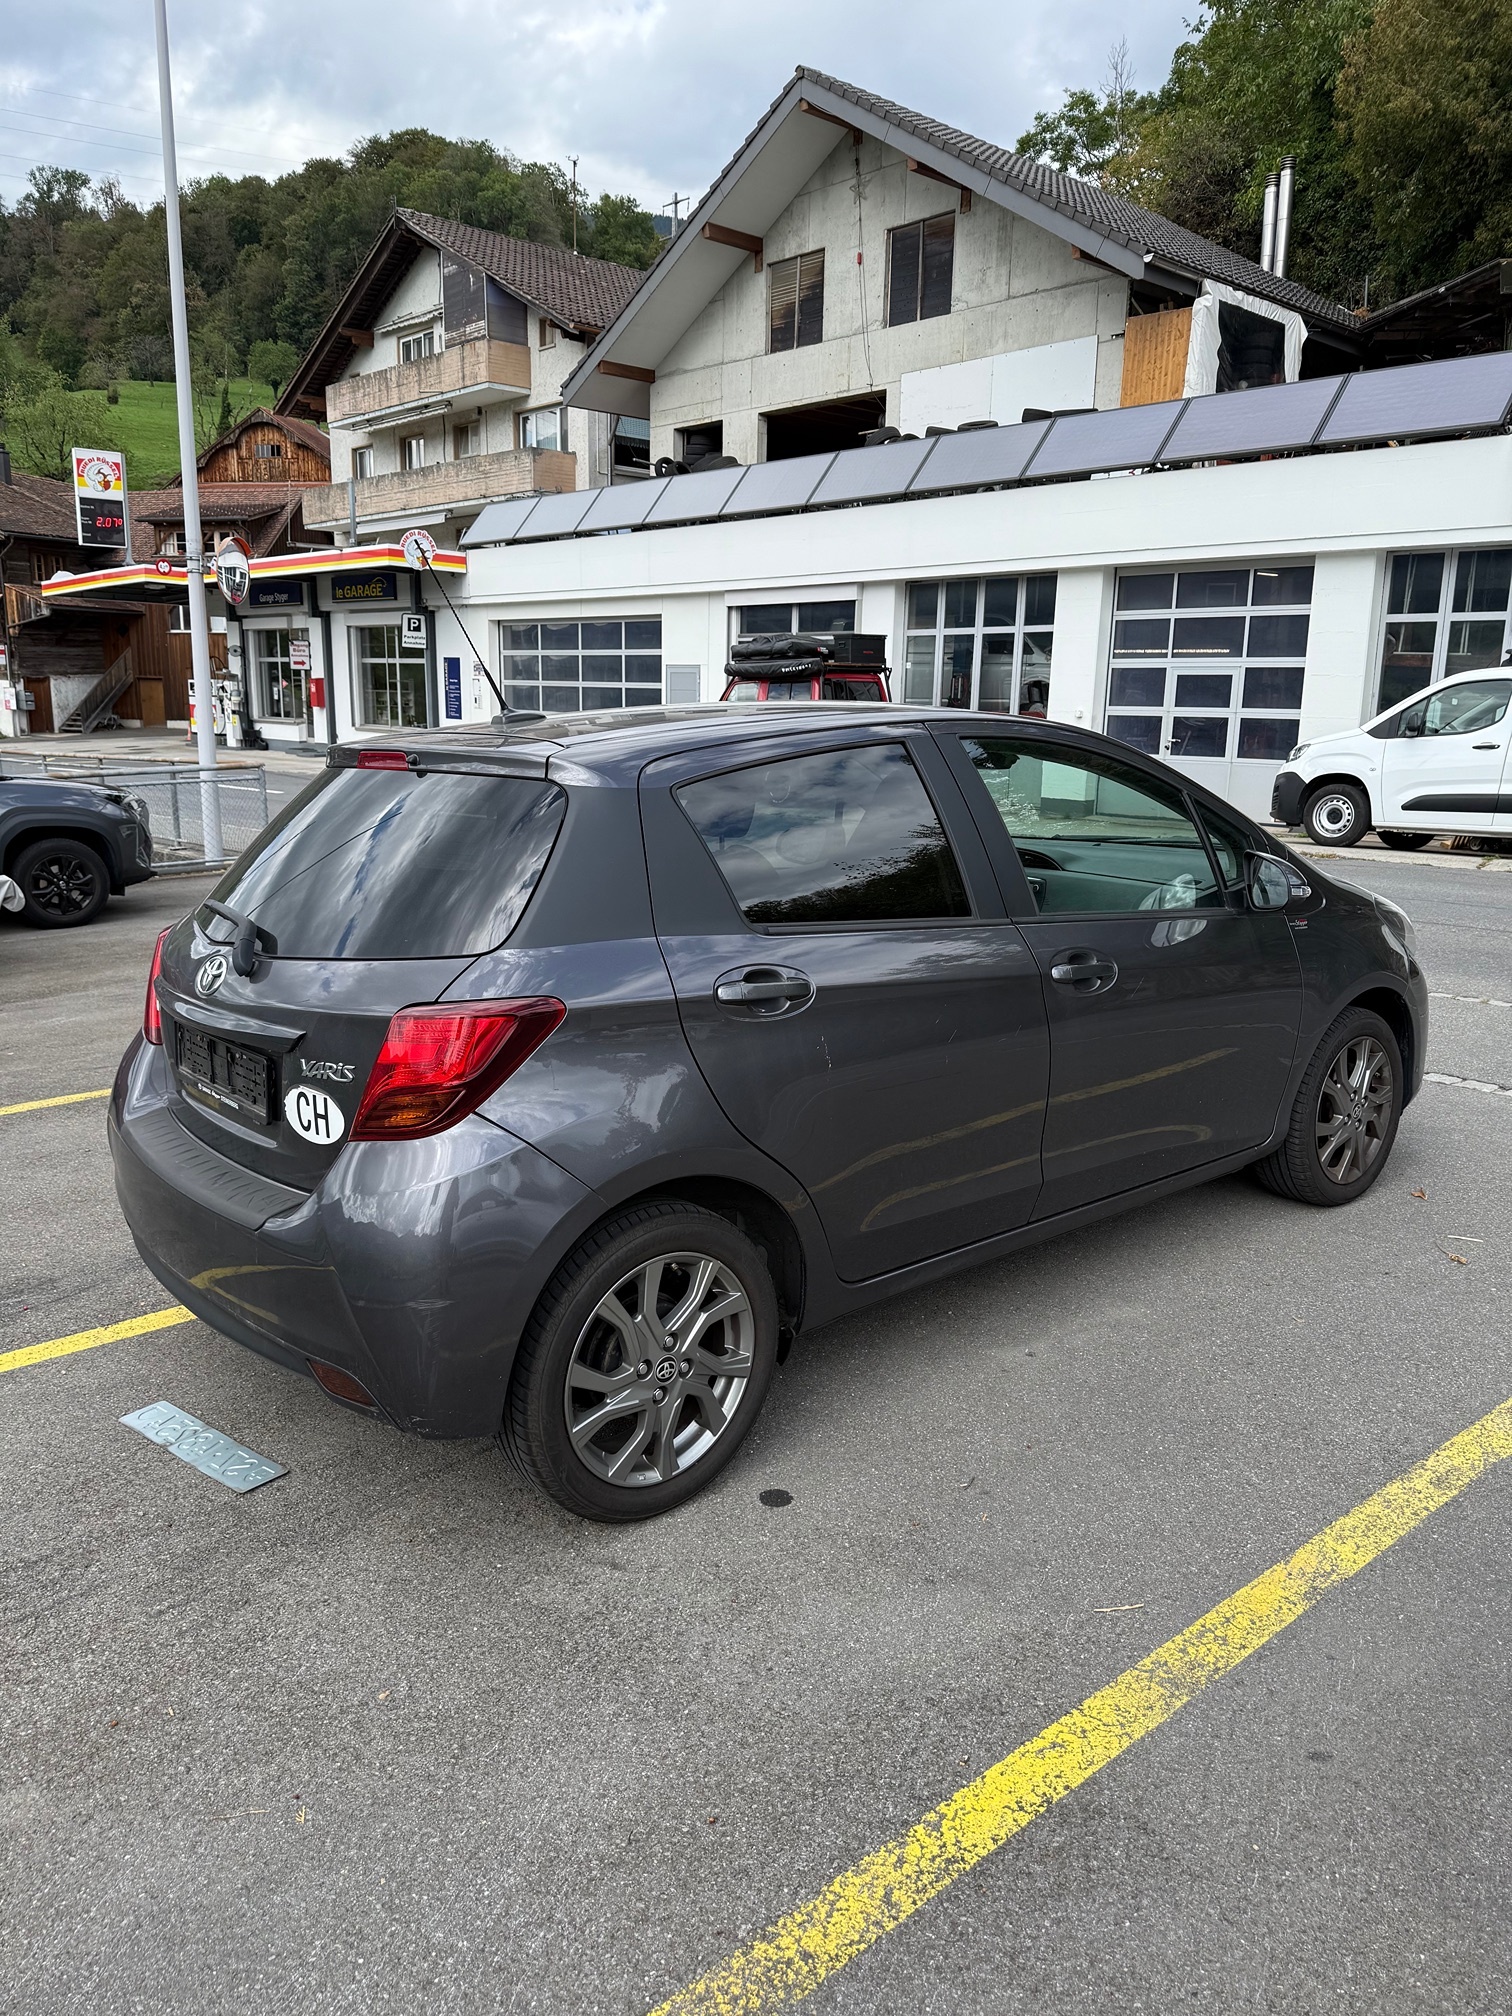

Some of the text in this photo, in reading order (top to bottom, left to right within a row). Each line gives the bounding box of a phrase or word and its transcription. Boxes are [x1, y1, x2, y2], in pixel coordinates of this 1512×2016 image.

[80, 456, 118, 478] RUEDI RÜSSEL
[400, 530, 437, 554] RUEDI RÜSSEL
[259, 592, 289, 604] Garage Styger
[335, 583, 383, 599] le GARAGE
[410, 619, 419, 631] P
[296, 1091, 331, 1139] CH
